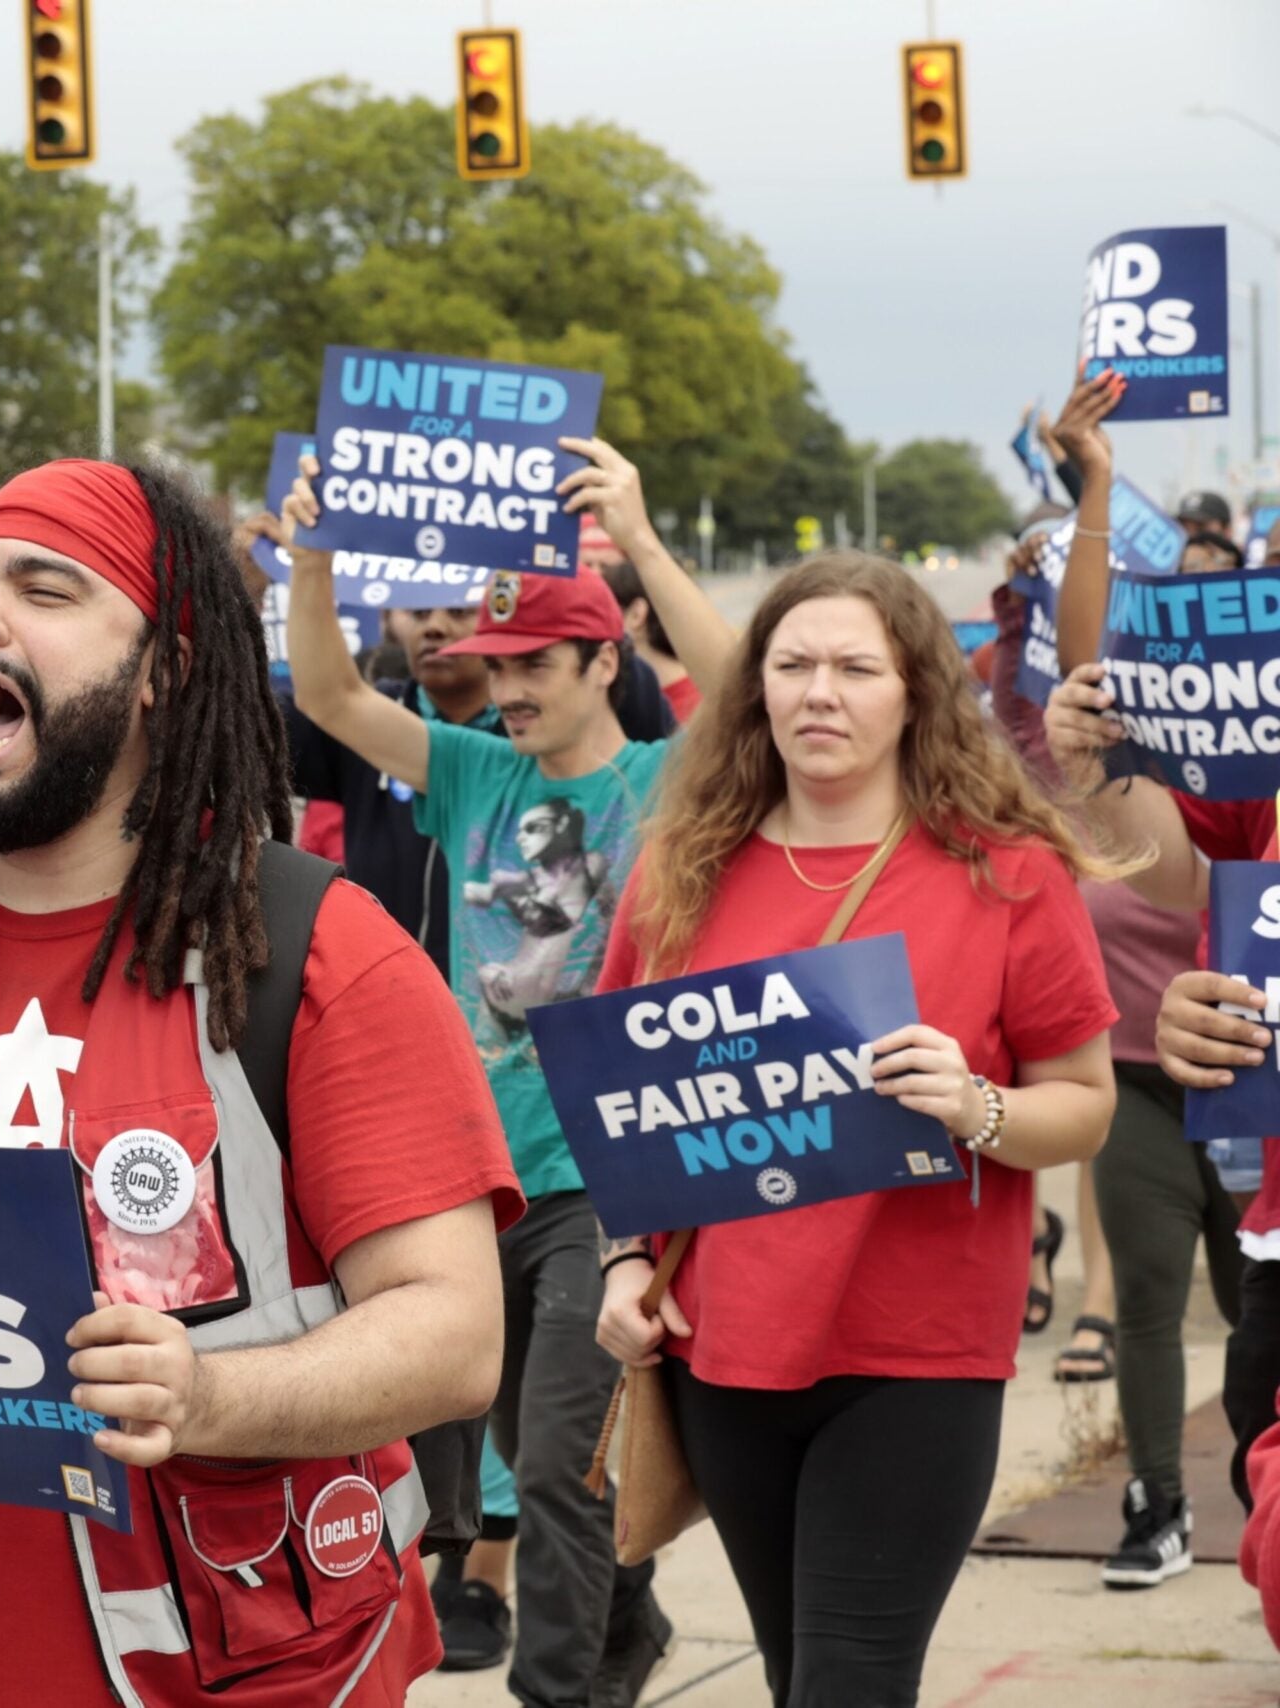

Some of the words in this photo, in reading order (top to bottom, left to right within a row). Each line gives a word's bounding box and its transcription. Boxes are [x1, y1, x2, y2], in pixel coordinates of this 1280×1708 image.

[1086, 242, 1161, 302] ND
[1111, 355, 1224, 378] WORKERS
[340, 356, 568, 424] UNITED
[408, 414, 452, 437] FOR
[455, 420, 474, 439] A
[329, 426, 556, 493] STRONG
[323, 475, 558, 535] CONTRACT
[1145, 641, 1183, 662] FOR
[1187, 641, 1205, 661] A
[625, 972, 810, 1050] COLA
[695, 1036, 758, 1069] AND
[595, 1071, 749, 1139] FAIR
[754, 1042, 876, 1109] PAY
[118, 1135, 147, 1148] UNITED
[148, 1136, 160, 1144] WE
[674, 1105, 833, 1177] NOW
[129, 1171, 161, 1191] UAW
[117, 1211, 138, 1225] Since
[315, 1516, 359, 1549] LOCAL
[362, 1509, 378, 1535] 51
